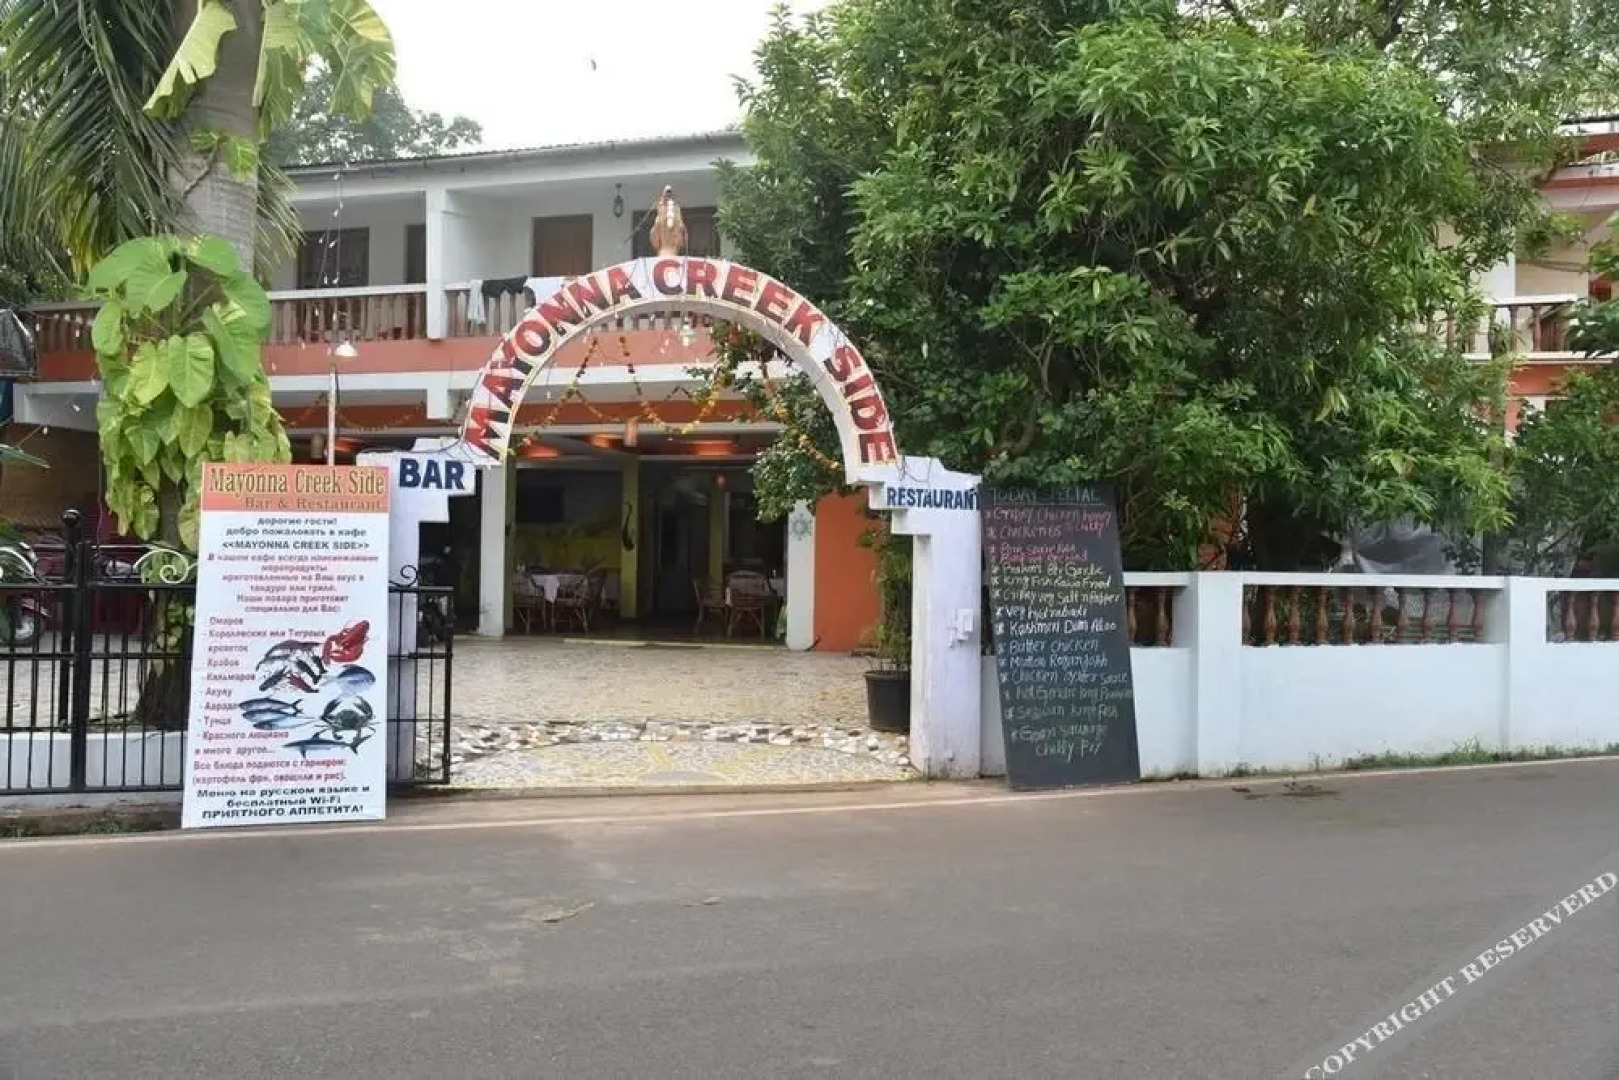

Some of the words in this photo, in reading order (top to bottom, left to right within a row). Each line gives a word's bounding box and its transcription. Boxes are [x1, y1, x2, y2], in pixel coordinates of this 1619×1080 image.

[465, 266, 642, 461] MAYONNA
[653, 259, 825, 348] CREEK
[824, 344, 897, 464] SIDE
[399, 458, 465, 490] BAR
[209, 467, 289, 497] Mayonna
[295, 469, 342, 494] Creek
[349, 469, 385, 495] Side
[245, 498, 272, 509] Bar
[278, 499, 287, 509] &
[297, 499, 382, 510] Restaurant
[226, 526, 259, 536] добро
[292, 541, 330, 550] CREEK
[201, 807, 285, 819] ПРИЯТНОГО
